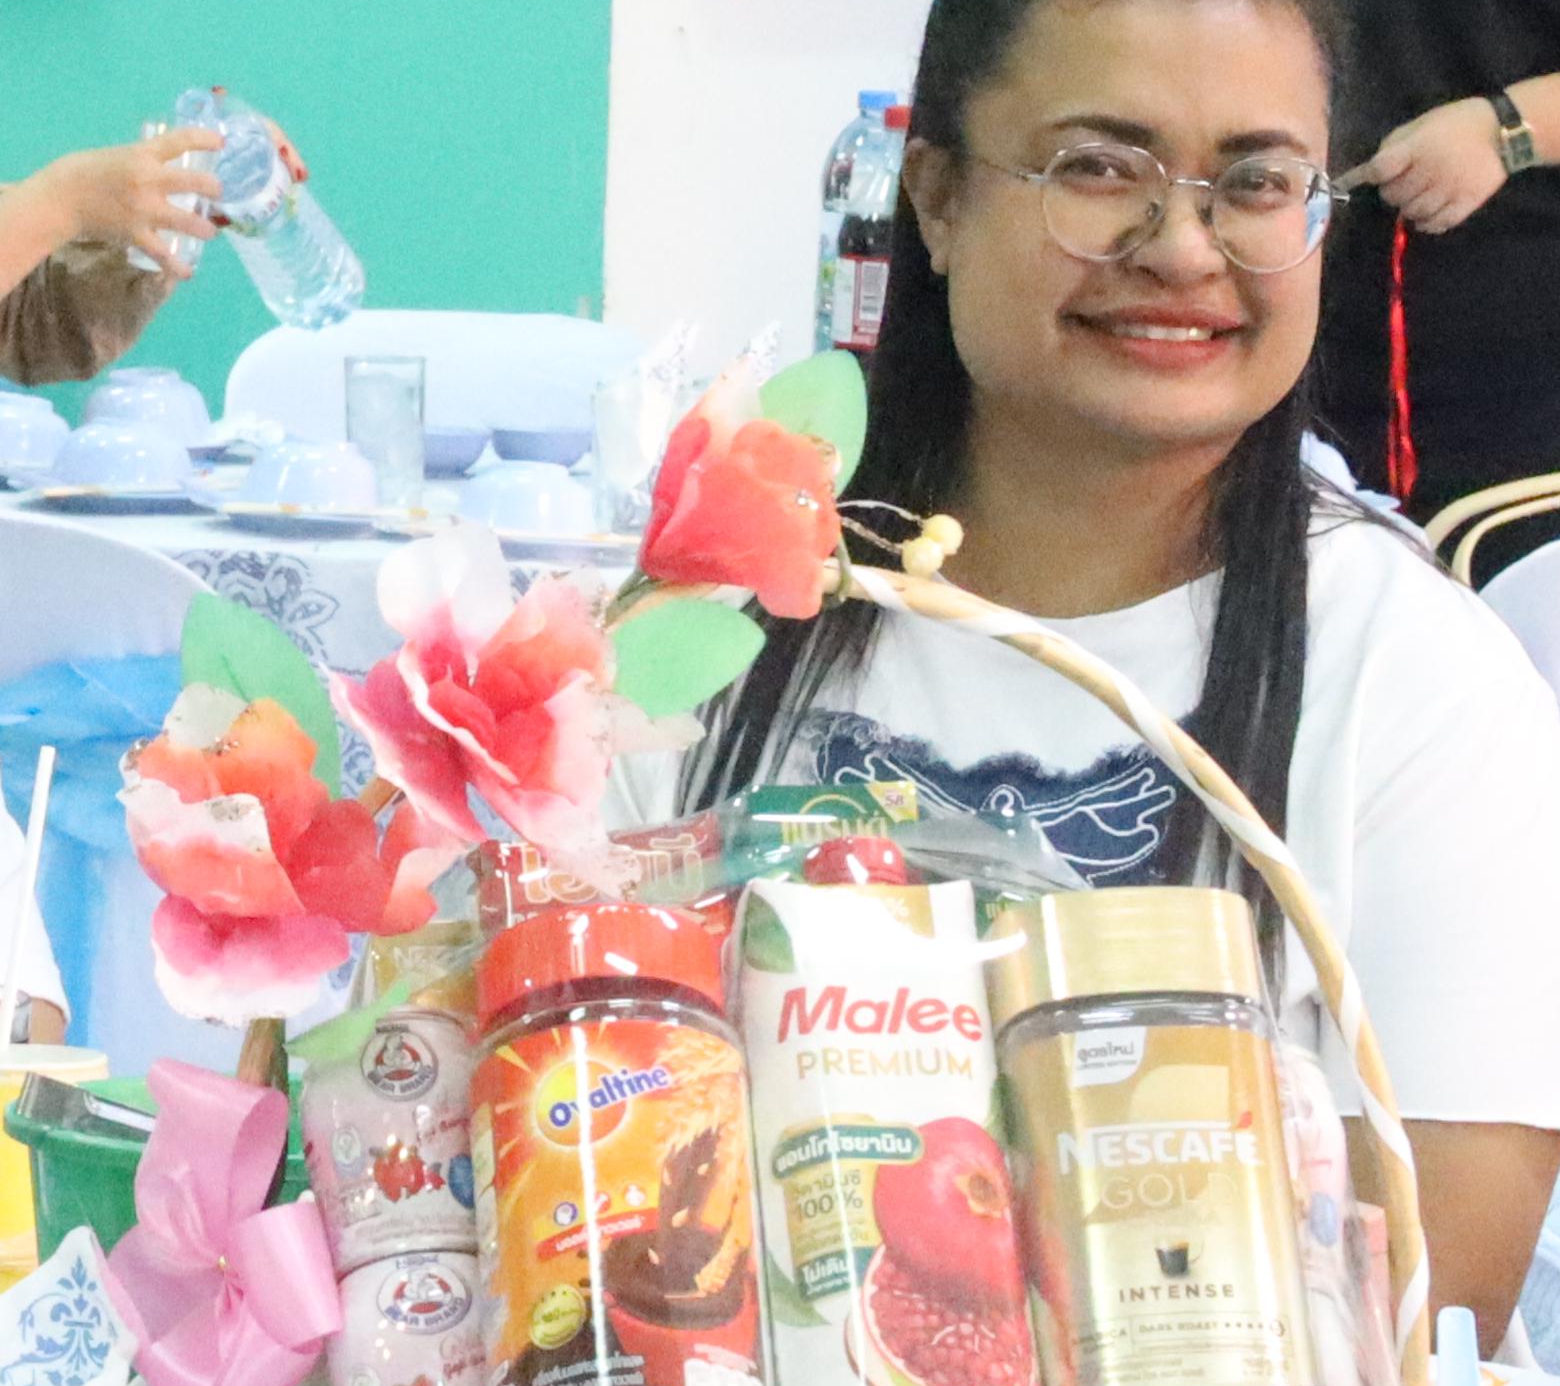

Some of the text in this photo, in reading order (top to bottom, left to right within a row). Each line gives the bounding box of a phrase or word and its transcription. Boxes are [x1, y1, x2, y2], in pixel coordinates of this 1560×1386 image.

[777, 985, 983, 1045] Malee
[796, 1047, 974, 1081] PREMIUM
[1057, 1111, 1263, 1176] NESCAFÉ
[1102, 1172, 1241, 1210] GOLD
[1118, 1282, 1236, 1304] INTENSE
[1177, 1320, 1219, 1333] ROAST
